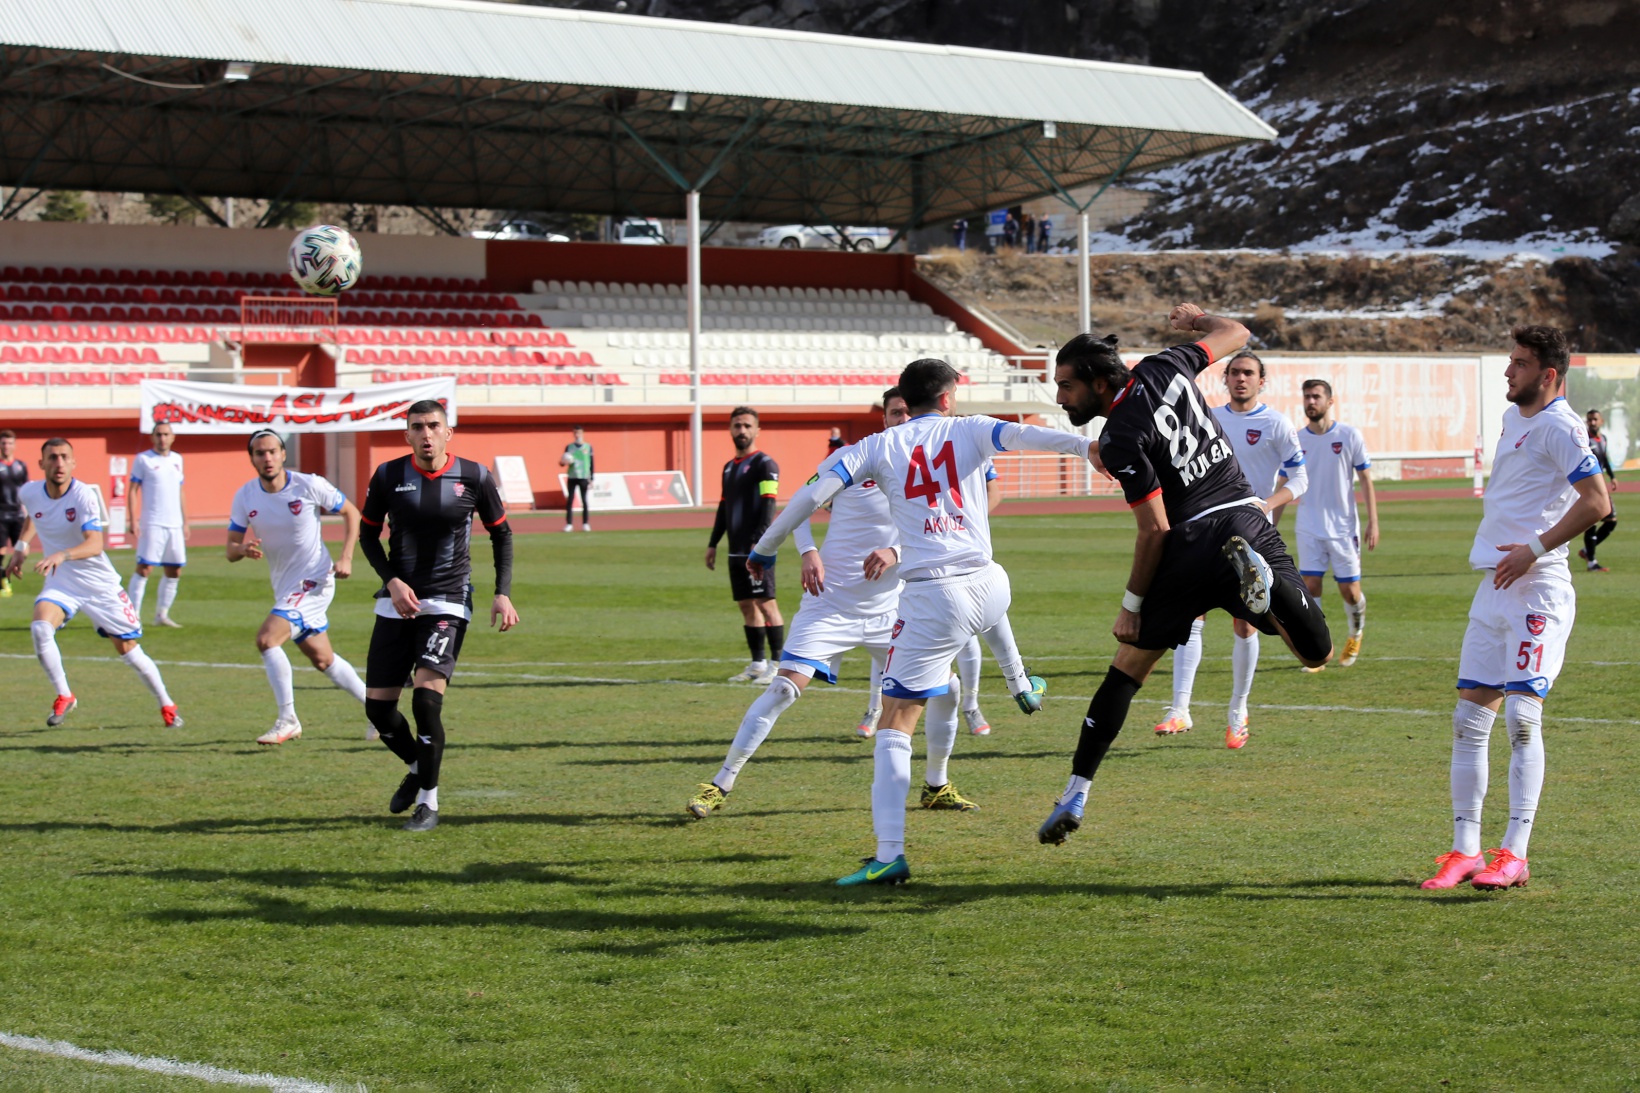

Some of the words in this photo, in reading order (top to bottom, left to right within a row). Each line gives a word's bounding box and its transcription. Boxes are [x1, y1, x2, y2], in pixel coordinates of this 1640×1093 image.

[904, 440, 964, 509] 41
[923, 512, 967, 535] AKYÜZ
[426, 631, 450, 657] 41
[1516, 640, 1544, 673] 51
